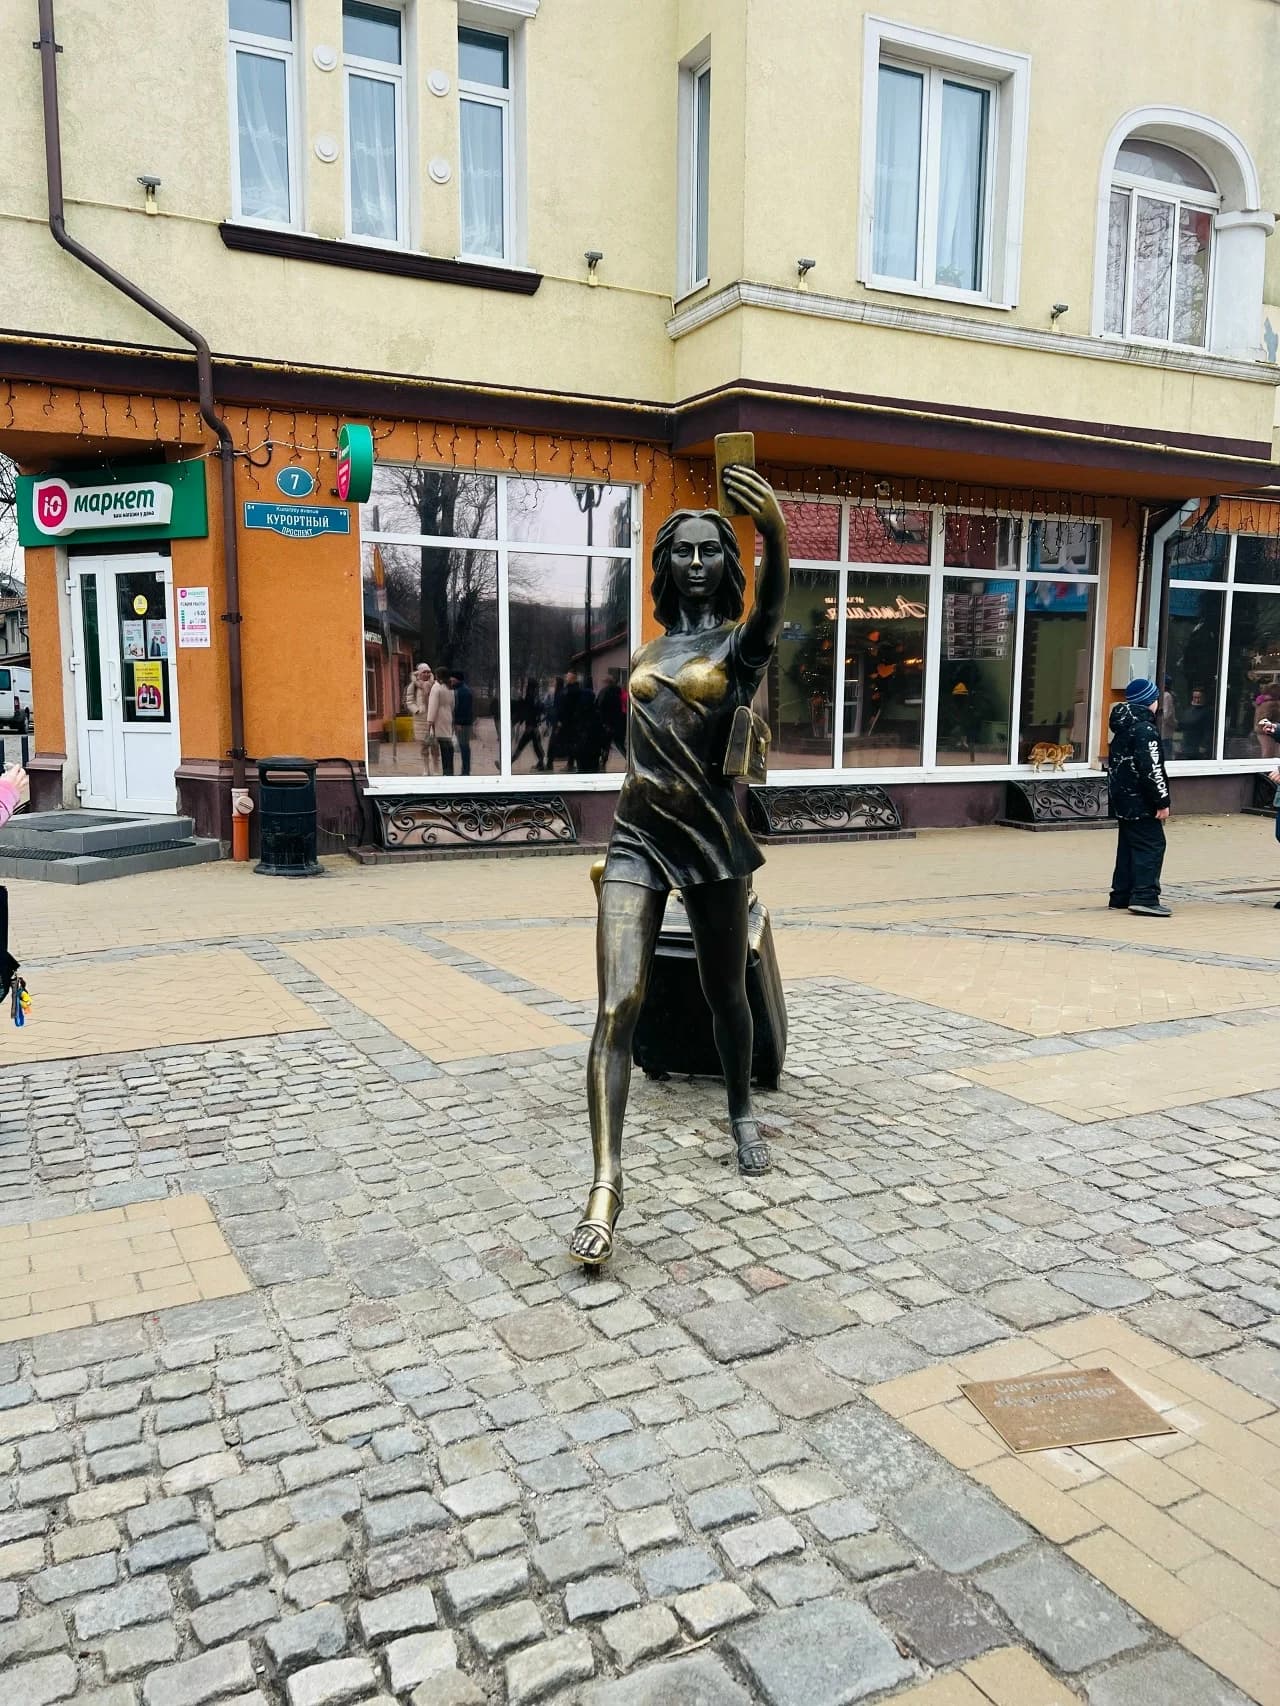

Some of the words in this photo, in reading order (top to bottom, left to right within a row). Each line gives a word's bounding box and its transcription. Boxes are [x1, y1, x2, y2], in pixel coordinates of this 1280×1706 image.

[290, 473, 300, 490] 7
[74, 489, 155, 515] маркет
[266, 513, 329, 528] КУРОРТНЫЙ
[281, 526, 313, 537] ПРОСПЕКТ
